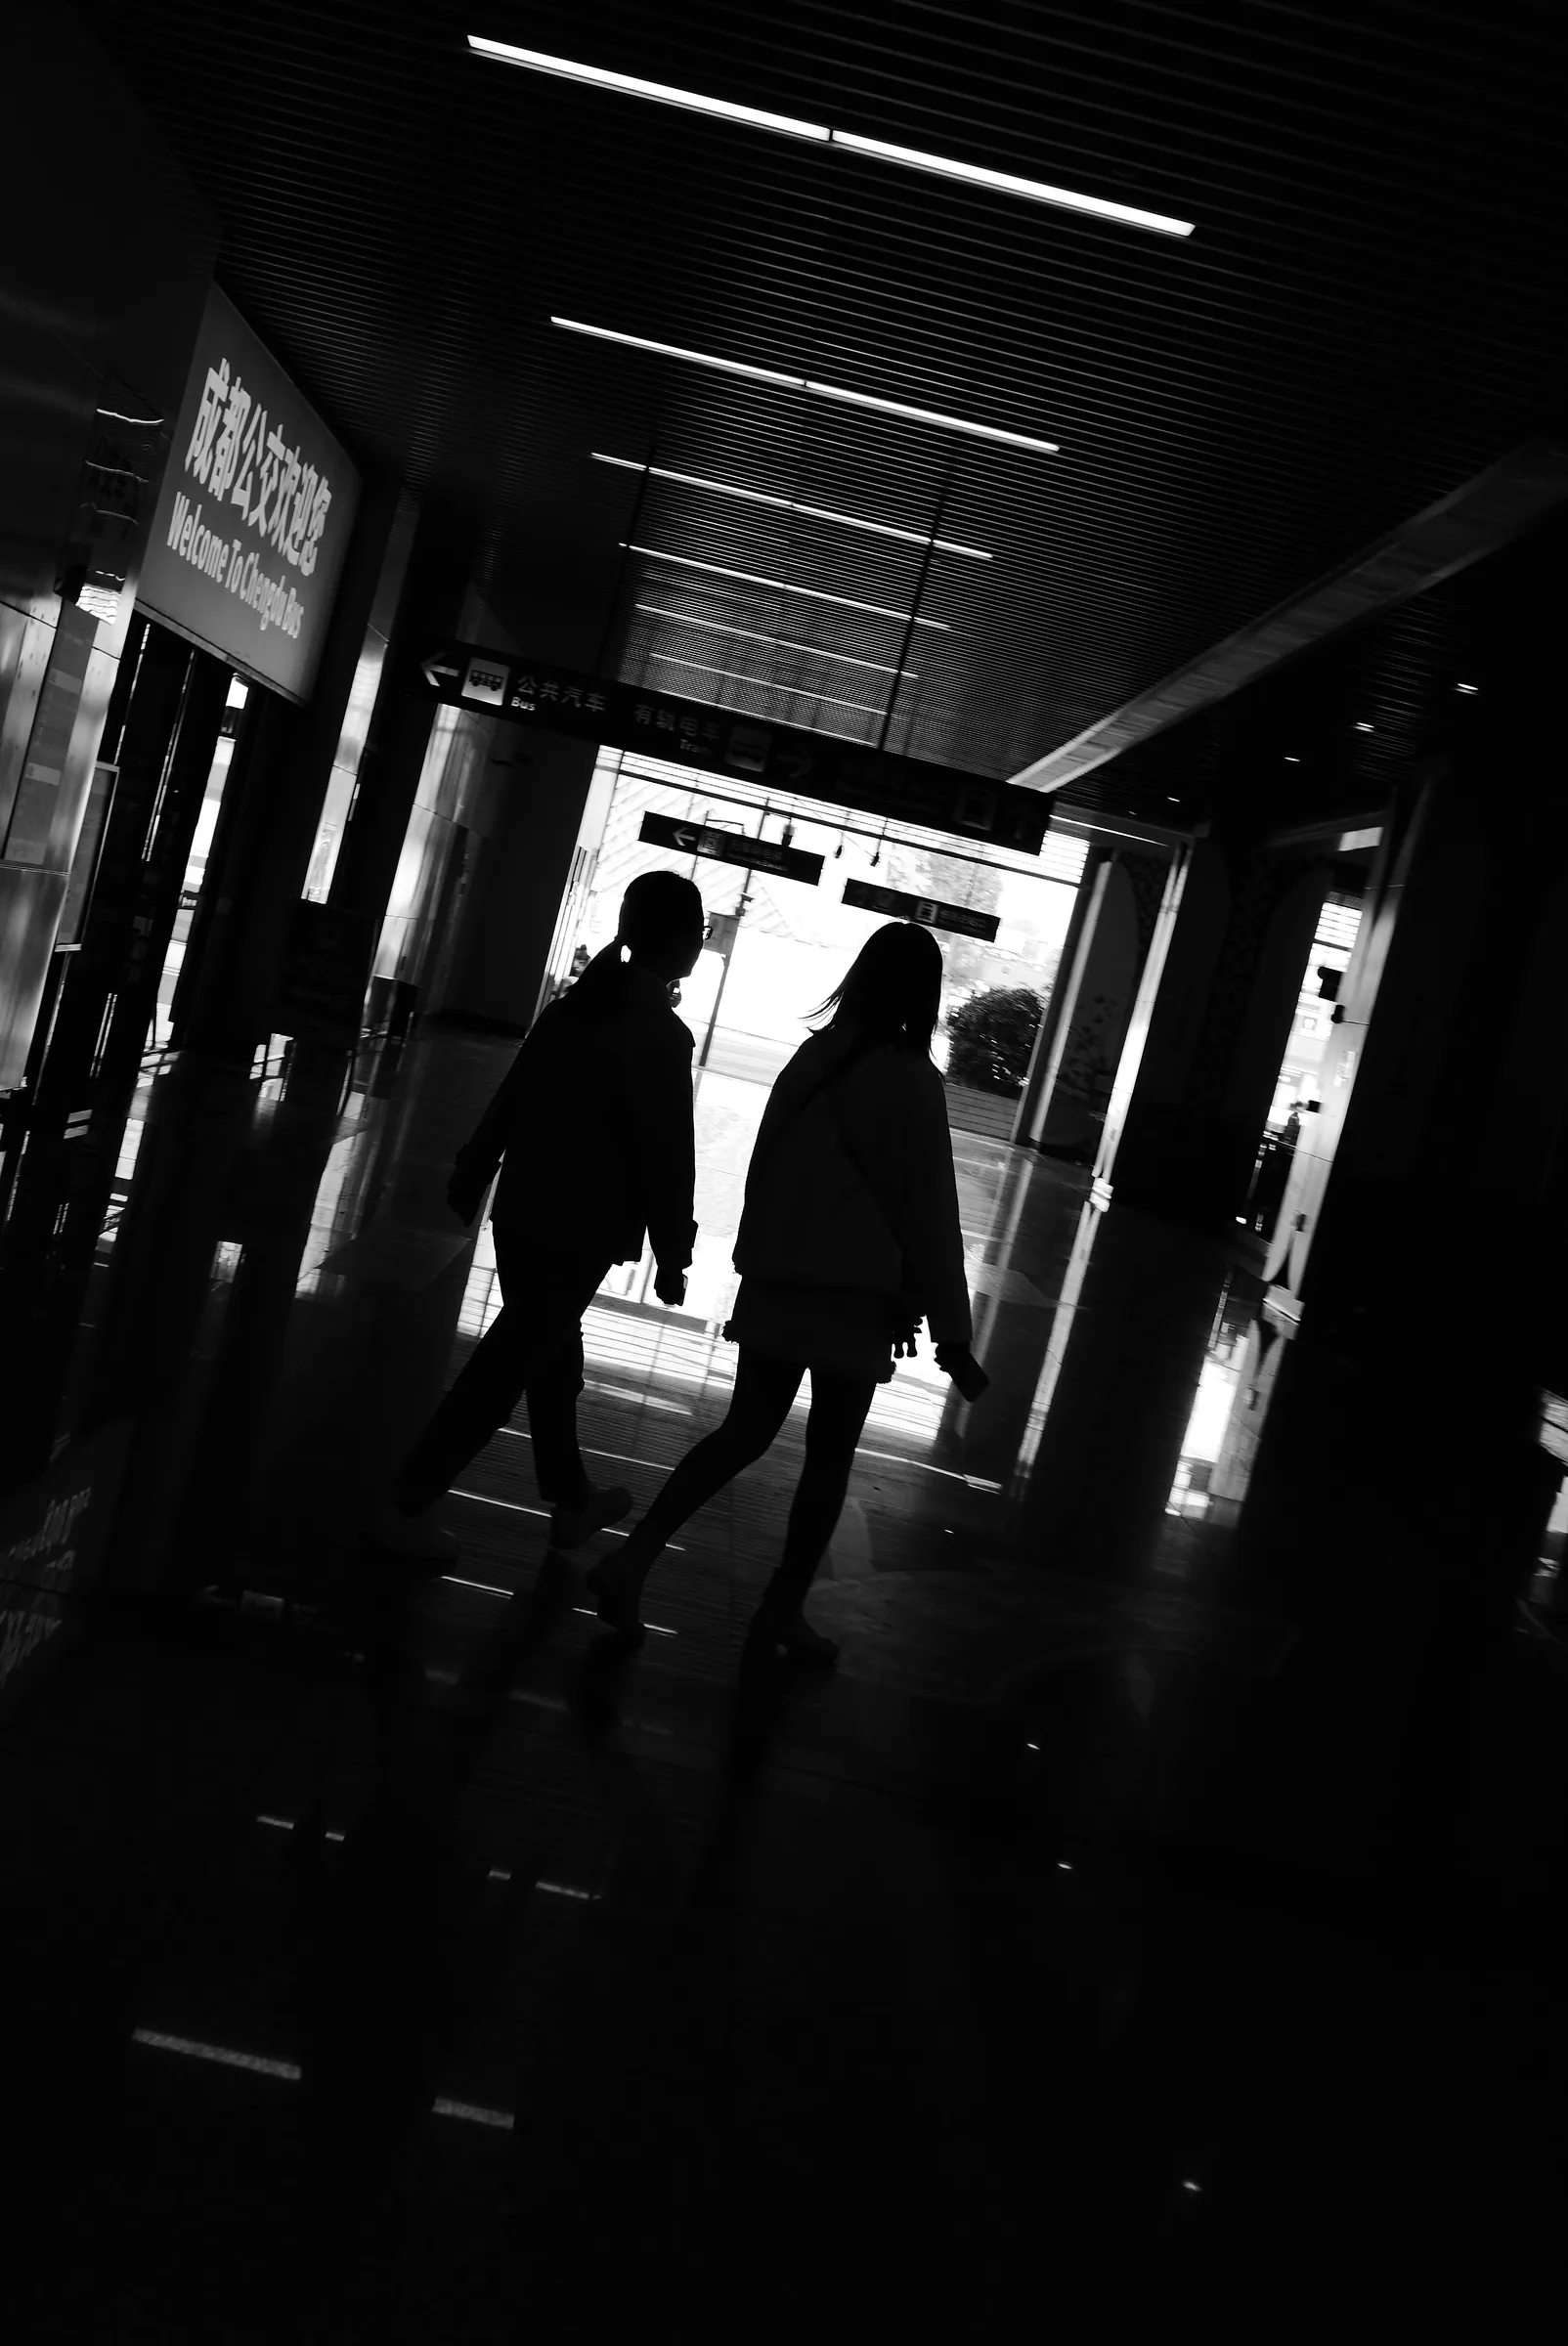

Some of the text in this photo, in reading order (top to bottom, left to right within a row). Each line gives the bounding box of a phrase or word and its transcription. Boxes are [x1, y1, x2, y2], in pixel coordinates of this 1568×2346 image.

[185, 358, 332, 576] 成都公交欢迎您
[166, 491, 304, 639] Welcome To Chengdu Bus
[511, 696, 536, 713] Bus
[517, 674, 608, 714] 公共汽车
